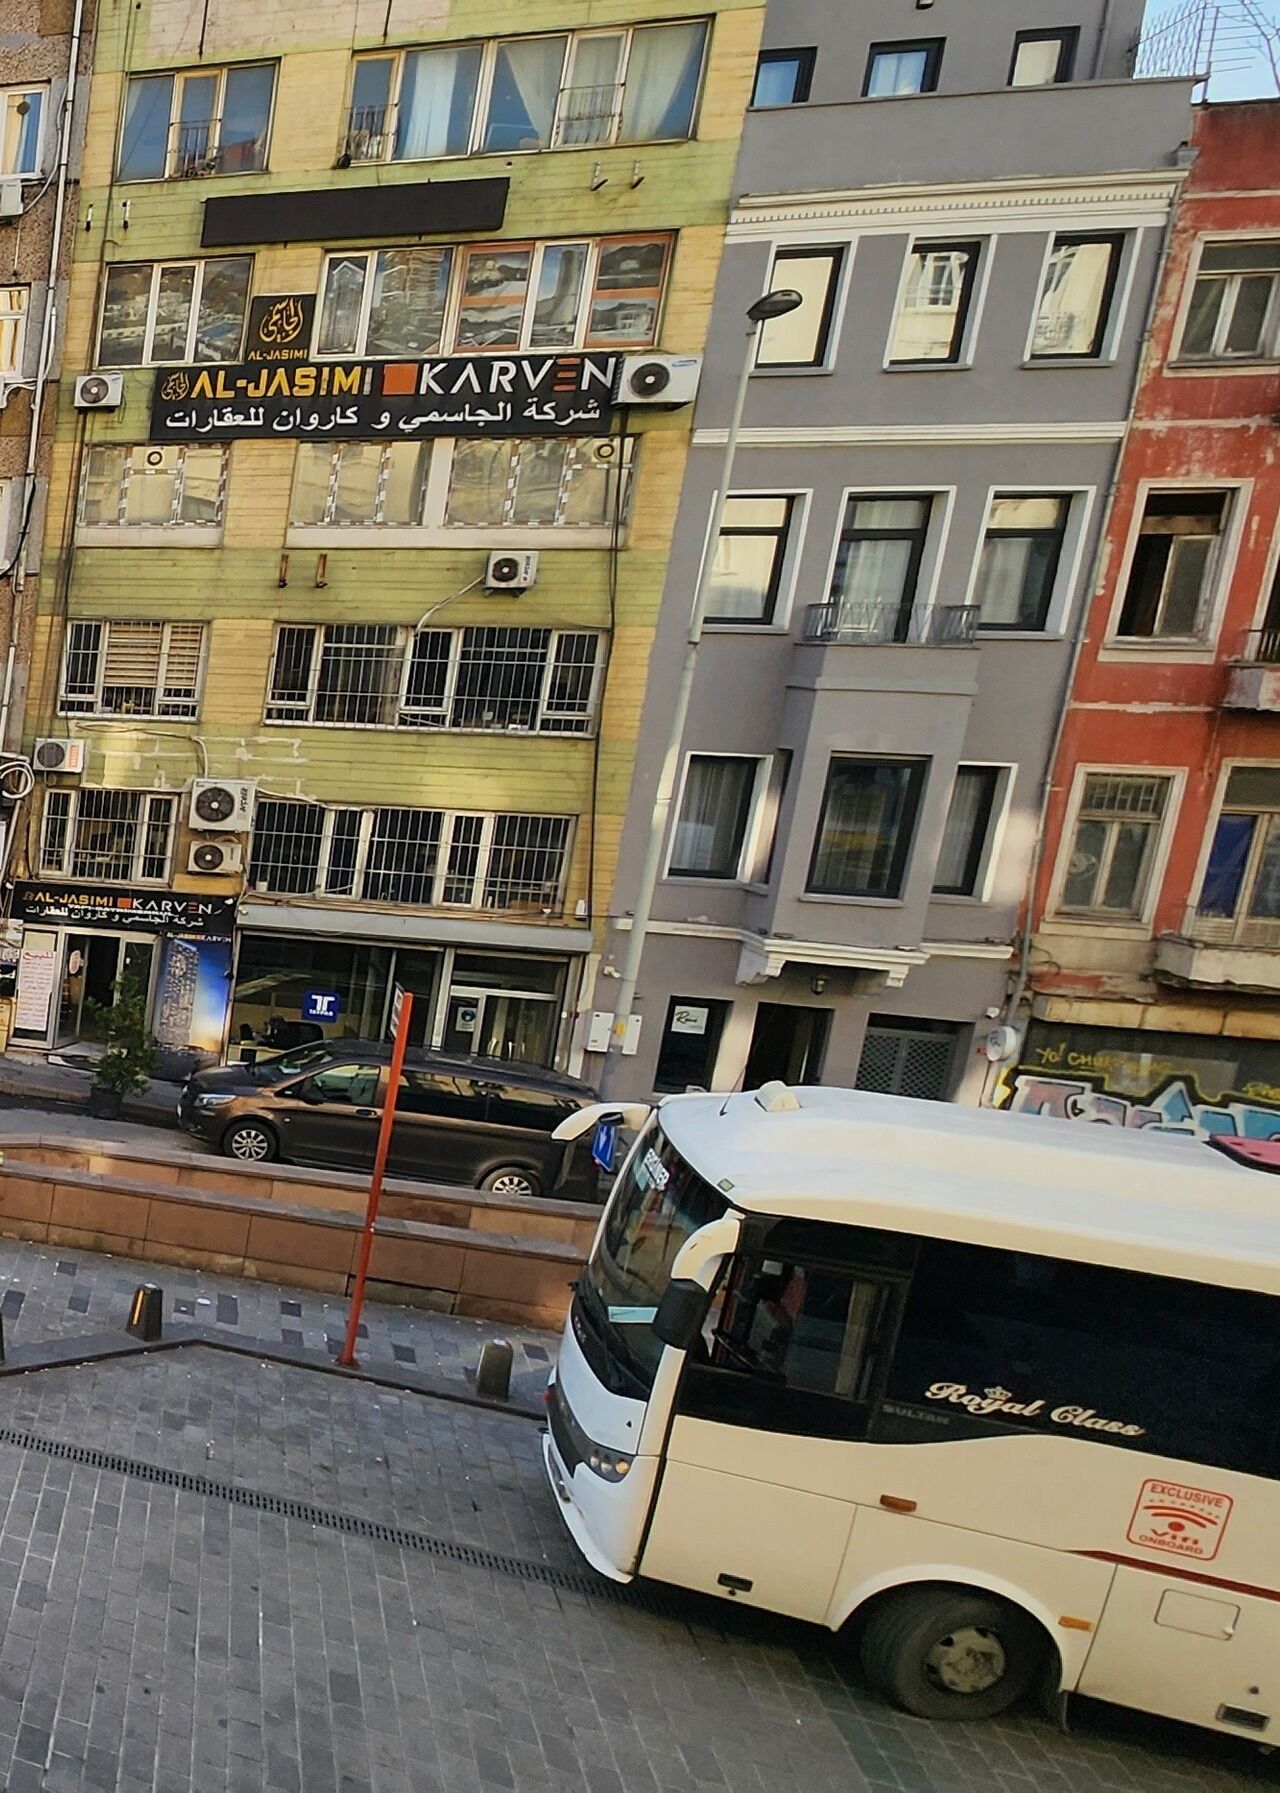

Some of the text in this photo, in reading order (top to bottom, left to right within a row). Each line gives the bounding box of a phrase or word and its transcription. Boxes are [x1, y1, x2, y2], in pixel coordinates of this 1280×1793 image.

[248, 348, 308, 360] AL-JASIMI
[191, 356, 618, 399] AL-JASIMI KARVEN
[165, 396, 600, 432] شركة الجاسمي و كاروان للعقارات
[34, 891, 113, 907] AL-JASIMI
[133, 898, 213, 915] KARVEN
[925, 1381, 1146, 1437] Royal Class
[1150, 1482, 1224, 1508] EXCLUSIVE
[1138, 1533, 1204, 1555] ONBOARD
